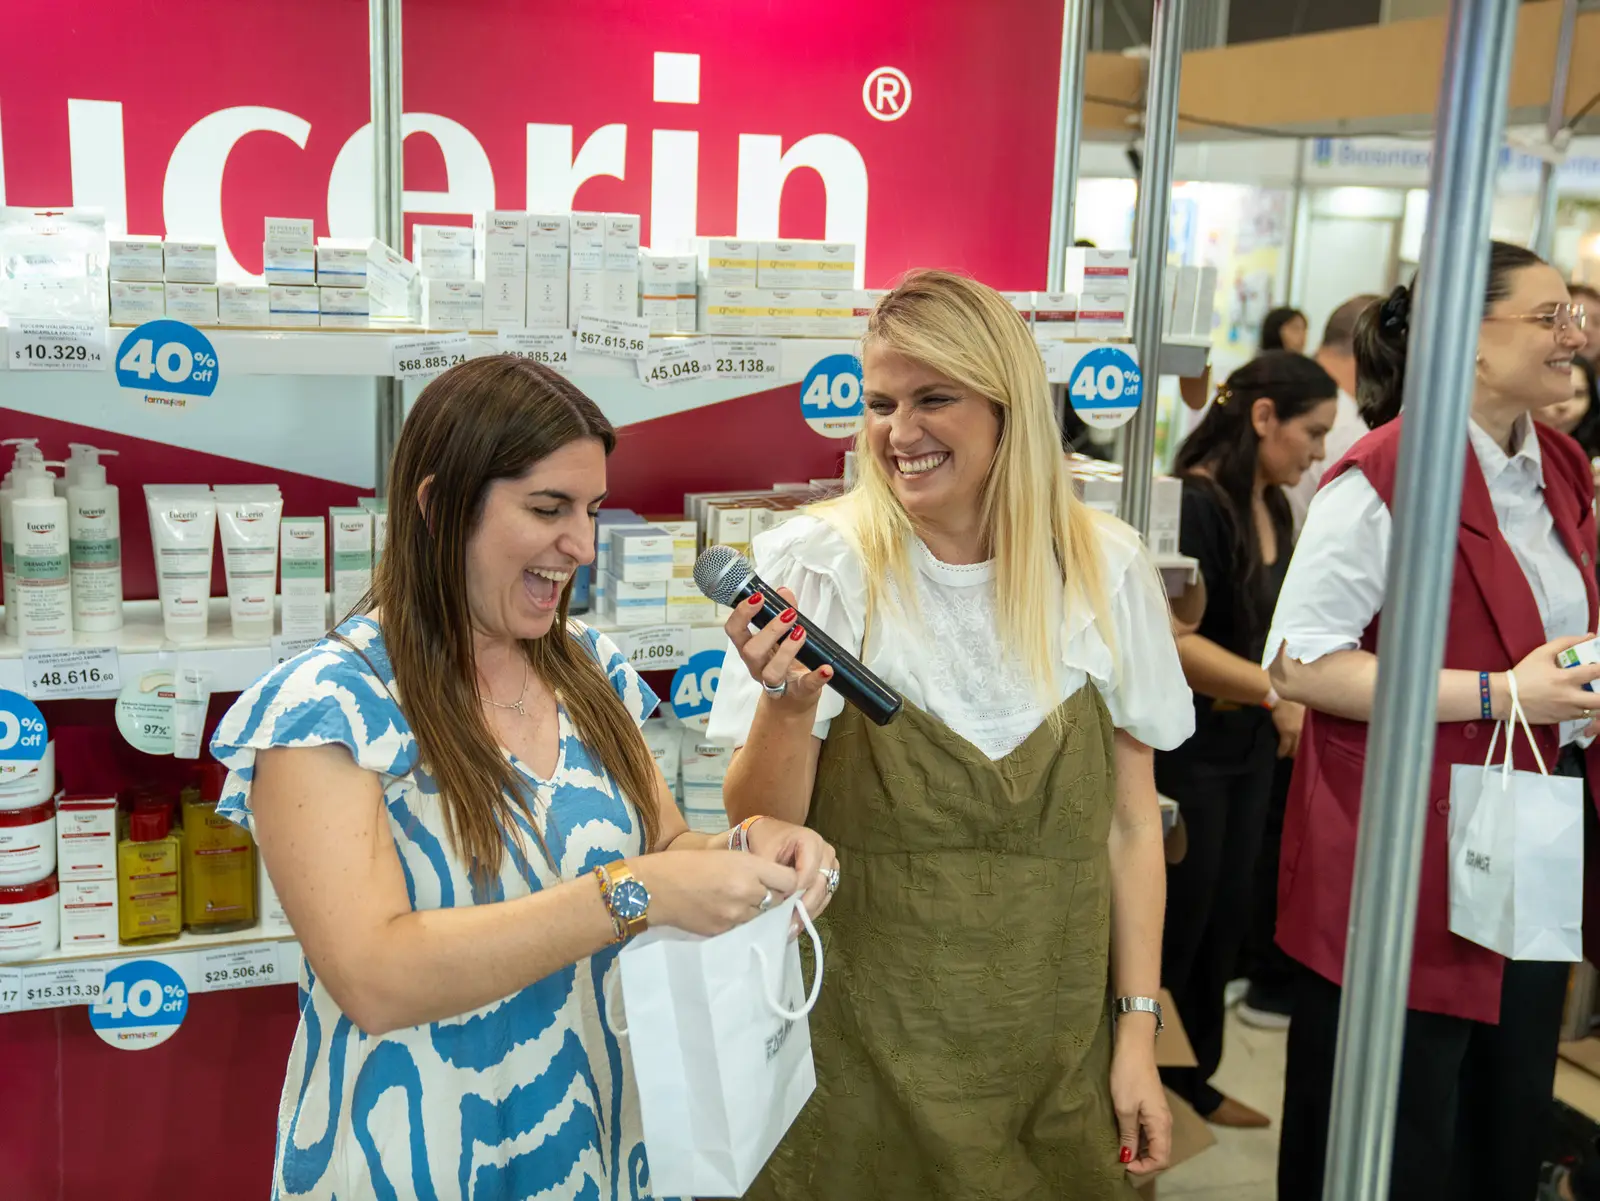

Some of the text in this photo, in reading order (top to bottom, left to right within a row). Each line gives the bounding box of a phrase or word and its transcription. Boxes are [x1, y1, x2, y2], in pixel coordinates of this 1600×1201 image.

[580, 332, 644, 351] $67.615,56
[25, 344, 101, 362] 10.329,14
[119, 338, 193, 383] 40
[398, 353, 466, 372] $68.885,24
[651, 359, 712, 380] 45.048,03
[192, 369, 213, 383] off
[1071, 365, 1124, 401] 40
[802, 372, 860, 410] 40
[1124, 384, 1139, 396] off
[79, 507, 106, 516] Eucerin
[169, 510, 198, 519] Eucerin
[27, 522, 56, 530] Eucerin
[40, 668, 114, 686] 48.616,60
[674, 667, 723, 708] 40
[20, 734, 42, 747] off
[205, 963, 274, 983] $29.506,46
[27, 985, 100, 1000] $15.313,39
[93, 978, 163, 1019] 40
[163, 1001, 182, 1012] off
